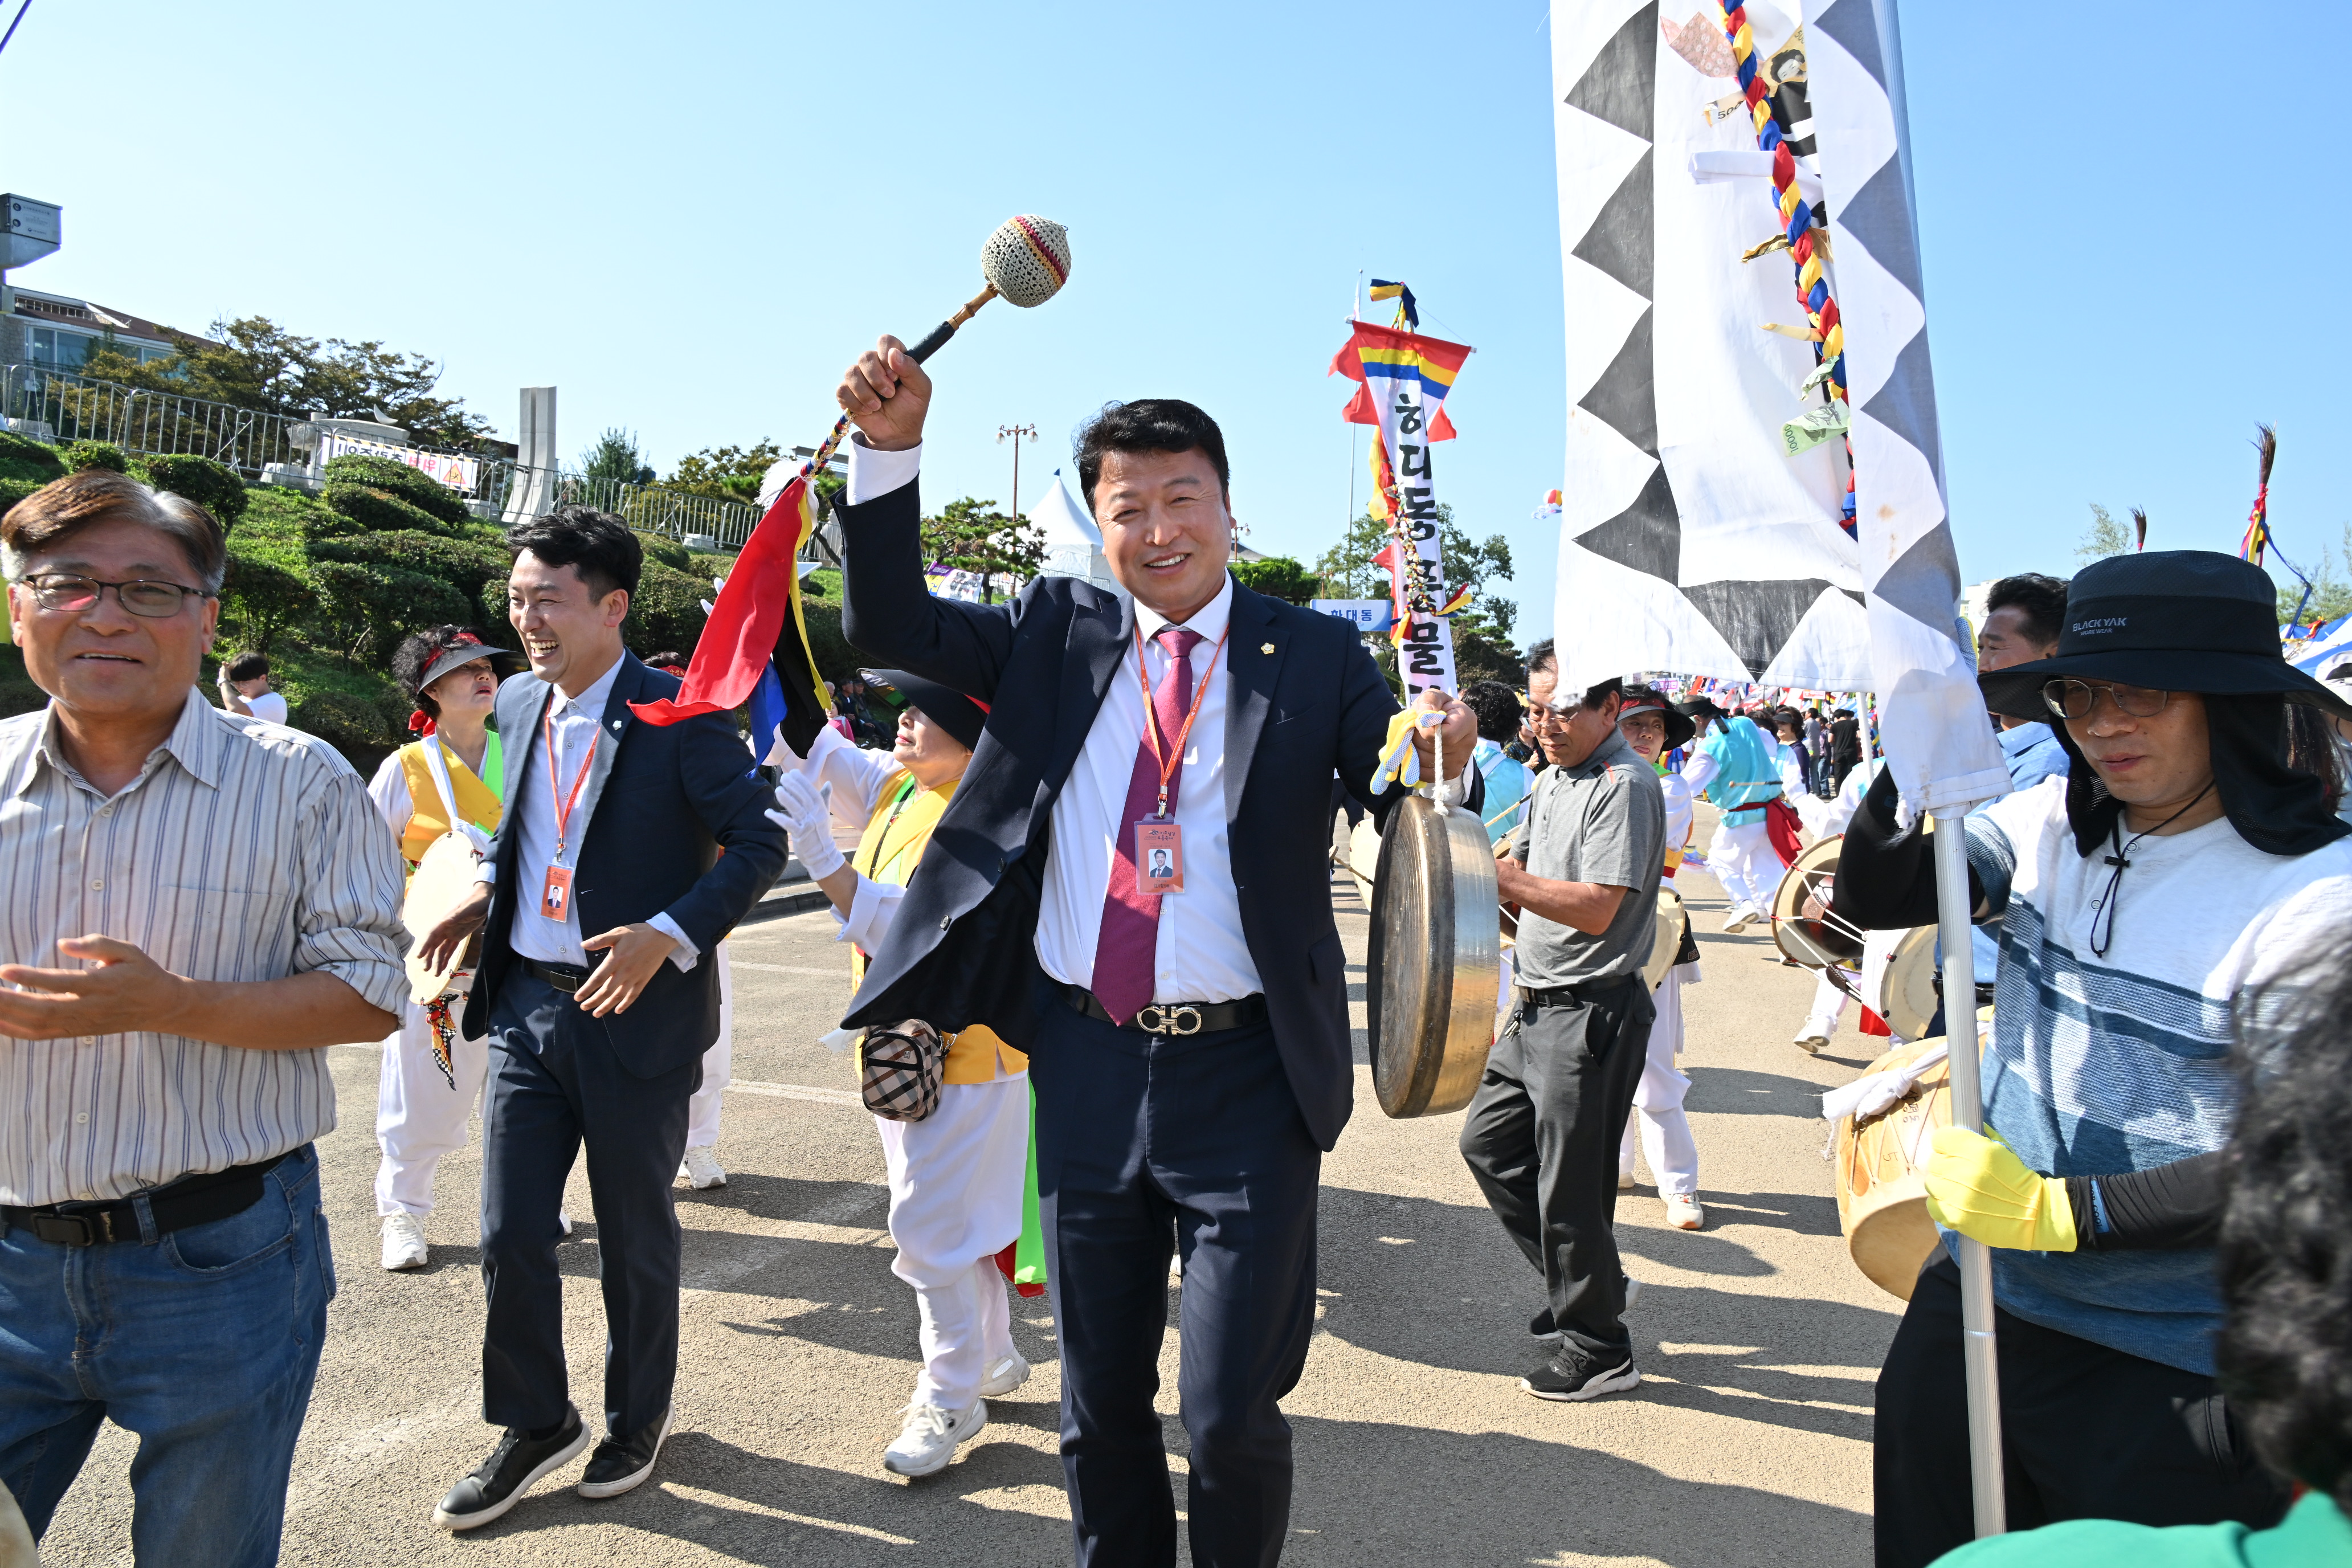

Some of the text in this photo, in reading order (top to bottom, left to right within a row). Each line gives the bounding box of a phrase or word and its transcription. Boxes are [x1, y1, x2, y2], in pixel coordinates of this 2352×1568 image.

[1784, 424, 1799, 453] 10000
[2072, 617, 2128, 632] BLACK YAK
[1883, 1152, 1898, 1162] 5
